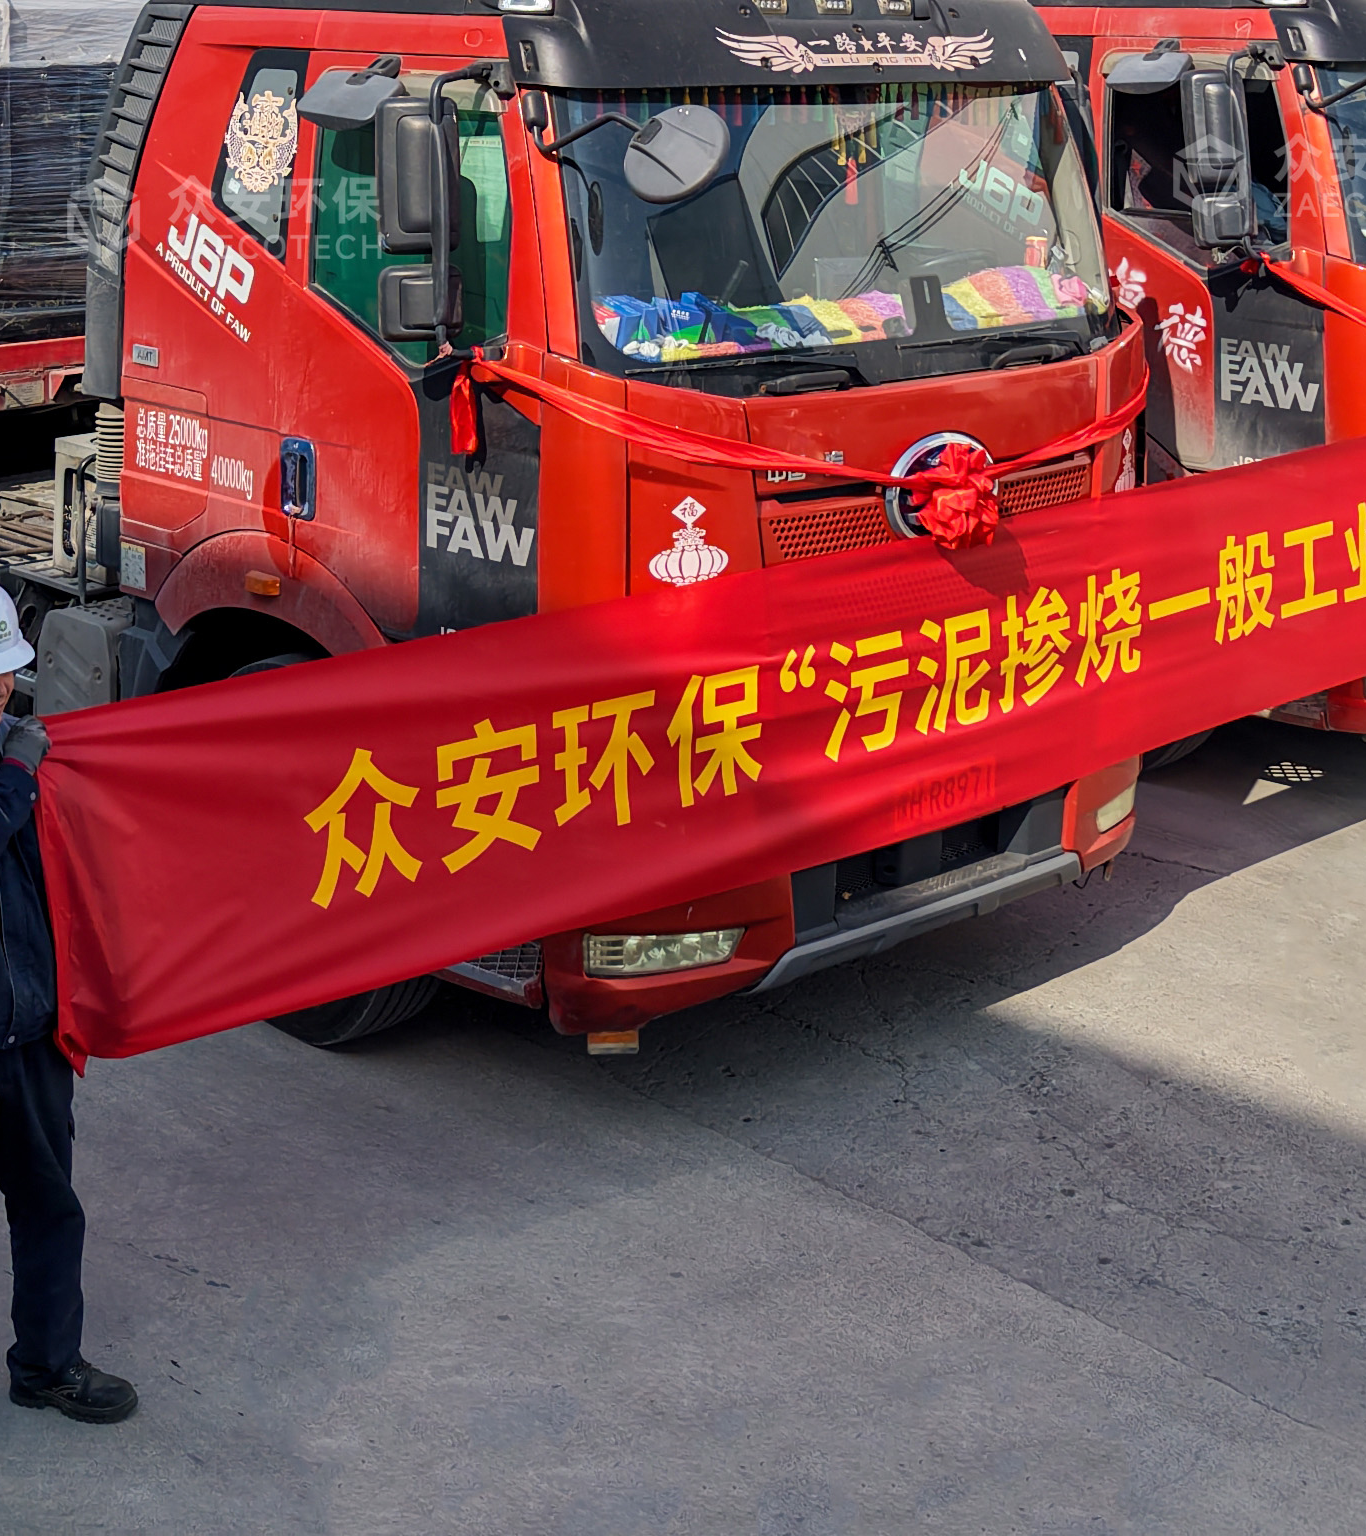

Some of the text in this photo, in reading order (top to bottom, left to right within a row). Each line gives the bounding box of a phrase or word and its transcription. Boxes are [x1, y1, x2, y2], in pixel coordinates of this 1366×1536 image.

[959, 159, 1044, 226] J6P
[168, 214, 255, 304] J6P
[155, 242, 251, 343] A PRODUCT OF FAW
[1220, 373, 1320, 412] FAW
[136, 408, 208, 459] 总质量 25000kg
[211, 454, 254, 501] 40000kg
[427, 508, 536, 567] FAW
